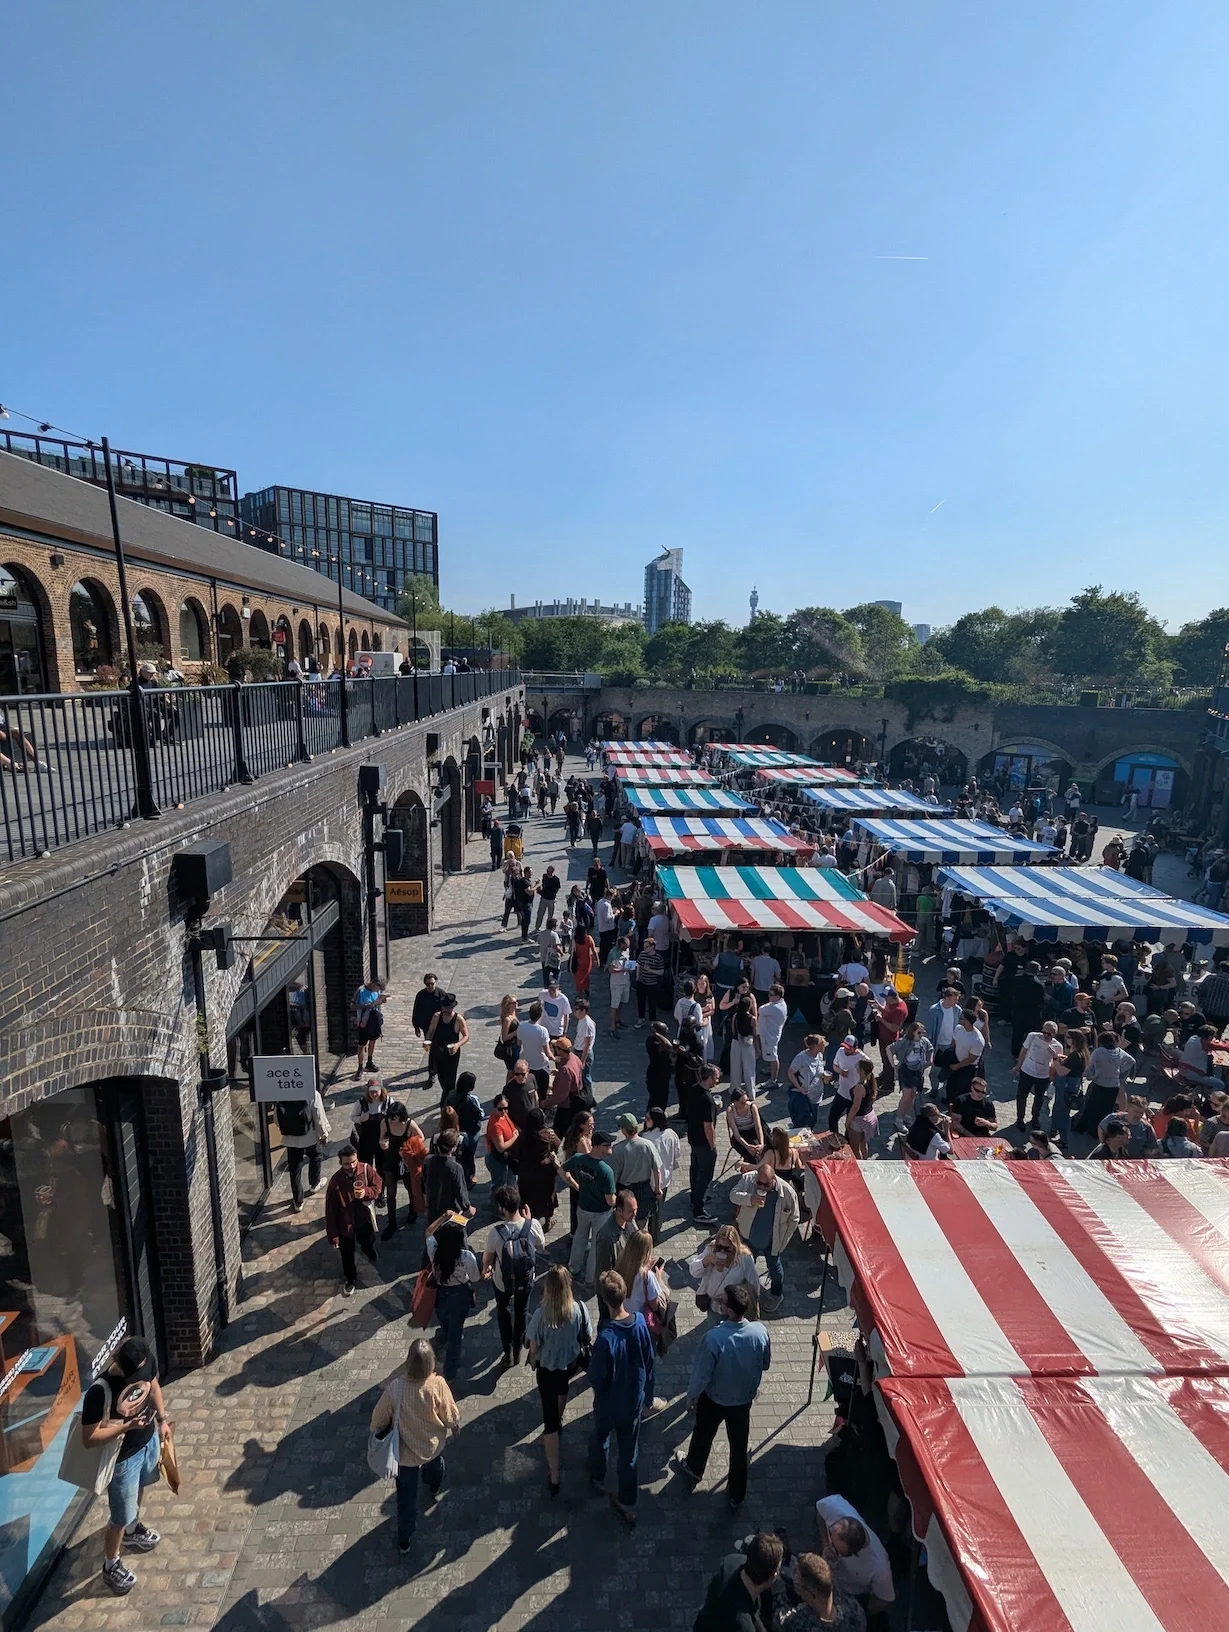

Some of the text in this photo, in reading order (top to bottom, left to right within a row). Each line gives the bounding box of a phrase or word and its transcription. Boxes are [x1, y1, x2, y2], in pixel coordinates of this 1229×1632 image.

[266, 1067, 302, 1078] ace &
[277, 1079, 304, 1089] tate
[91, 1315, 126, 1370] FOR YOUR
[91, 1321, 128, 1380] EYES ONLY
